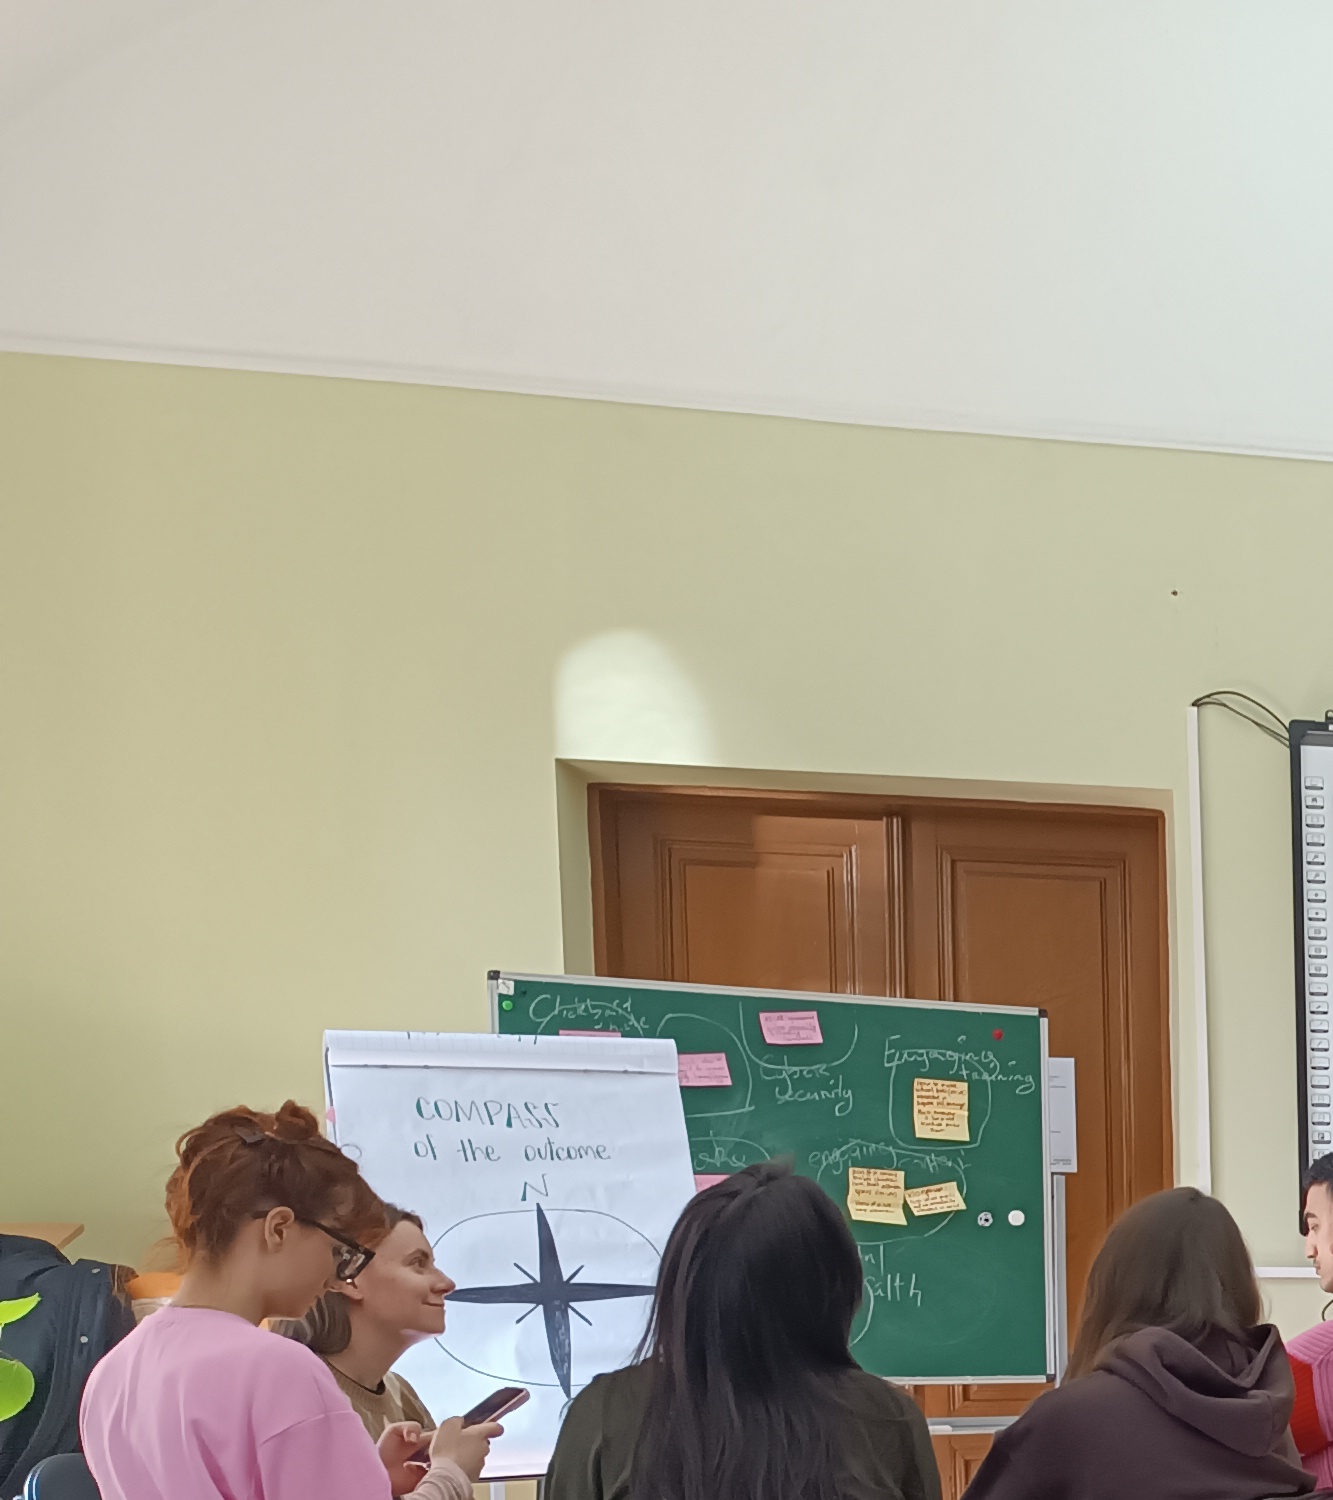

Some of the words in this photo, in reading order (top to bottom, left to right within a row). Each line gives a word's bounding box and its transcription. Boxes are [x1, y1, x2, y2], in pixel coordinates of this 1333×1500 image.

[415, 1096, 560, 1129] COMPASS
[413, 1133, 438, 1161] of
[456, 1138, 501, 1162] the
[524, 1136, 612, 1162] outcome
[520, 1173, 550, 1202] N
